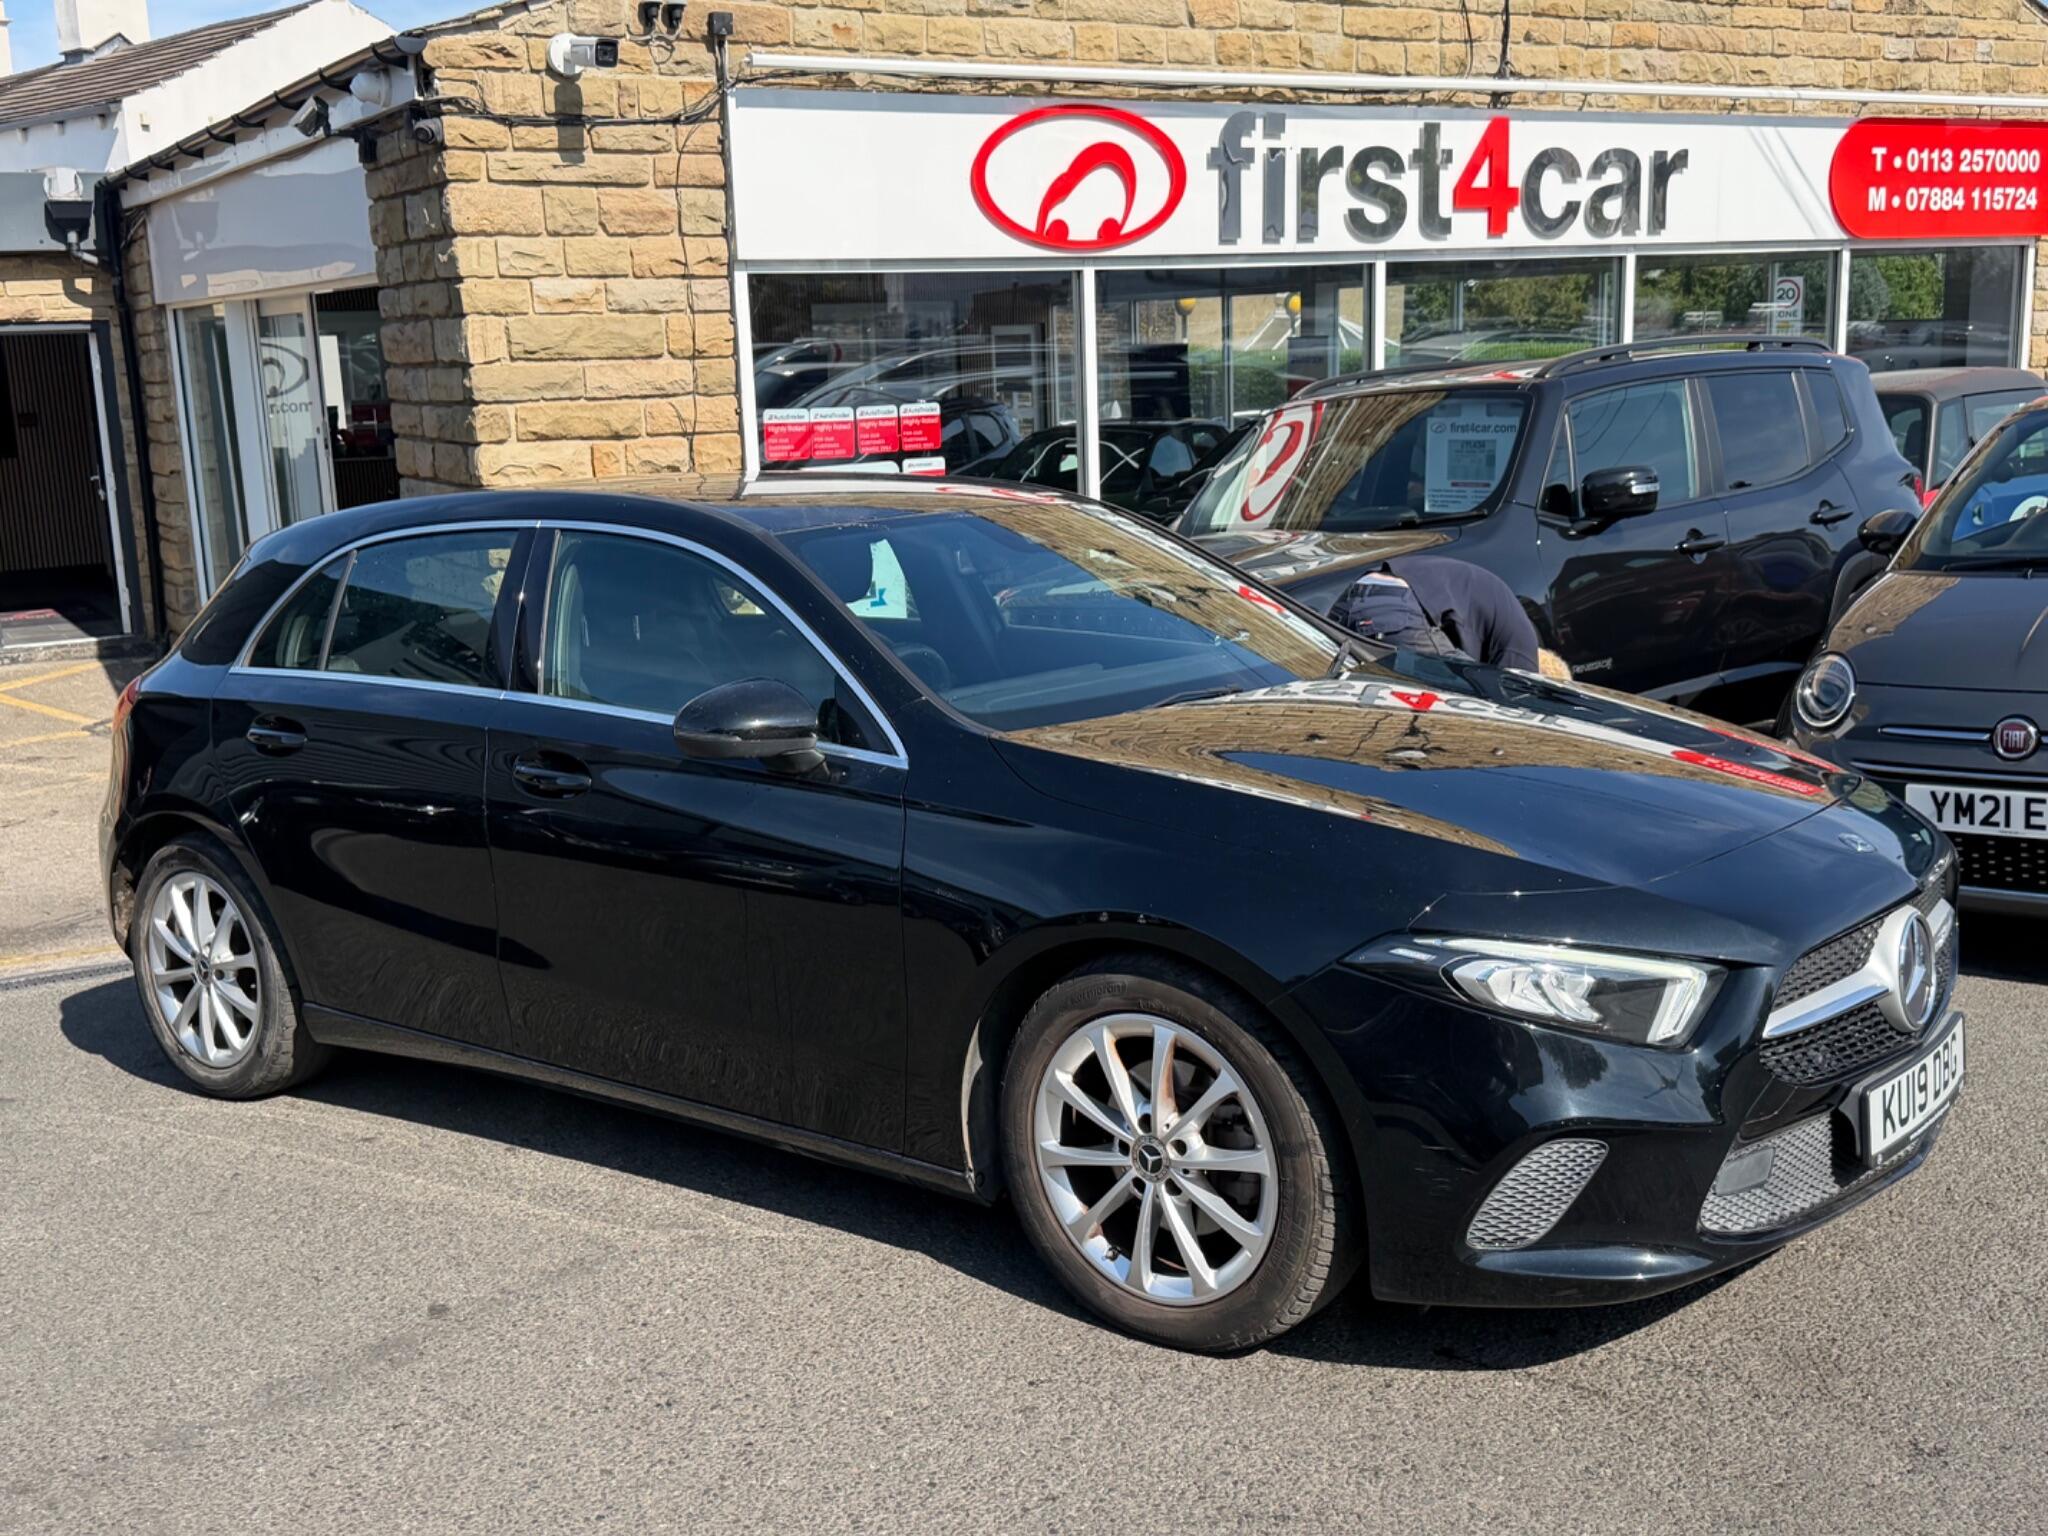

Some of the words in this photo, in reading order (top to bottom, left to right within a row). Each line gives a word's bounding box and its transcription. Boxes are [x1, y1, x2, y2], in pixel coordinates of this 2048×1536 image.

[1871, 147, 1887, 172] T
[1906, 148, 1953, 172] 0113
[1959, 148, 2041, 173] 2570000
[1206, 111, 1688, 245] first4car
[1868, 187, 1887, 211] M
[1905, 187, 1965, 211] 07884
[1971, 187, 2038, 211] 115724
[1777, 287, 1795, 300] 20
[1776, 310, 1798, 318] ONE
[1450, 422, 1517, 433] first4car.com
[2003, 730, 2026, 749] FIAT
[1930, 790, 2011, 829] YM21
[2024, 797, 2047, 831] E
[1882, 1062, 1928, 1140] KU19
